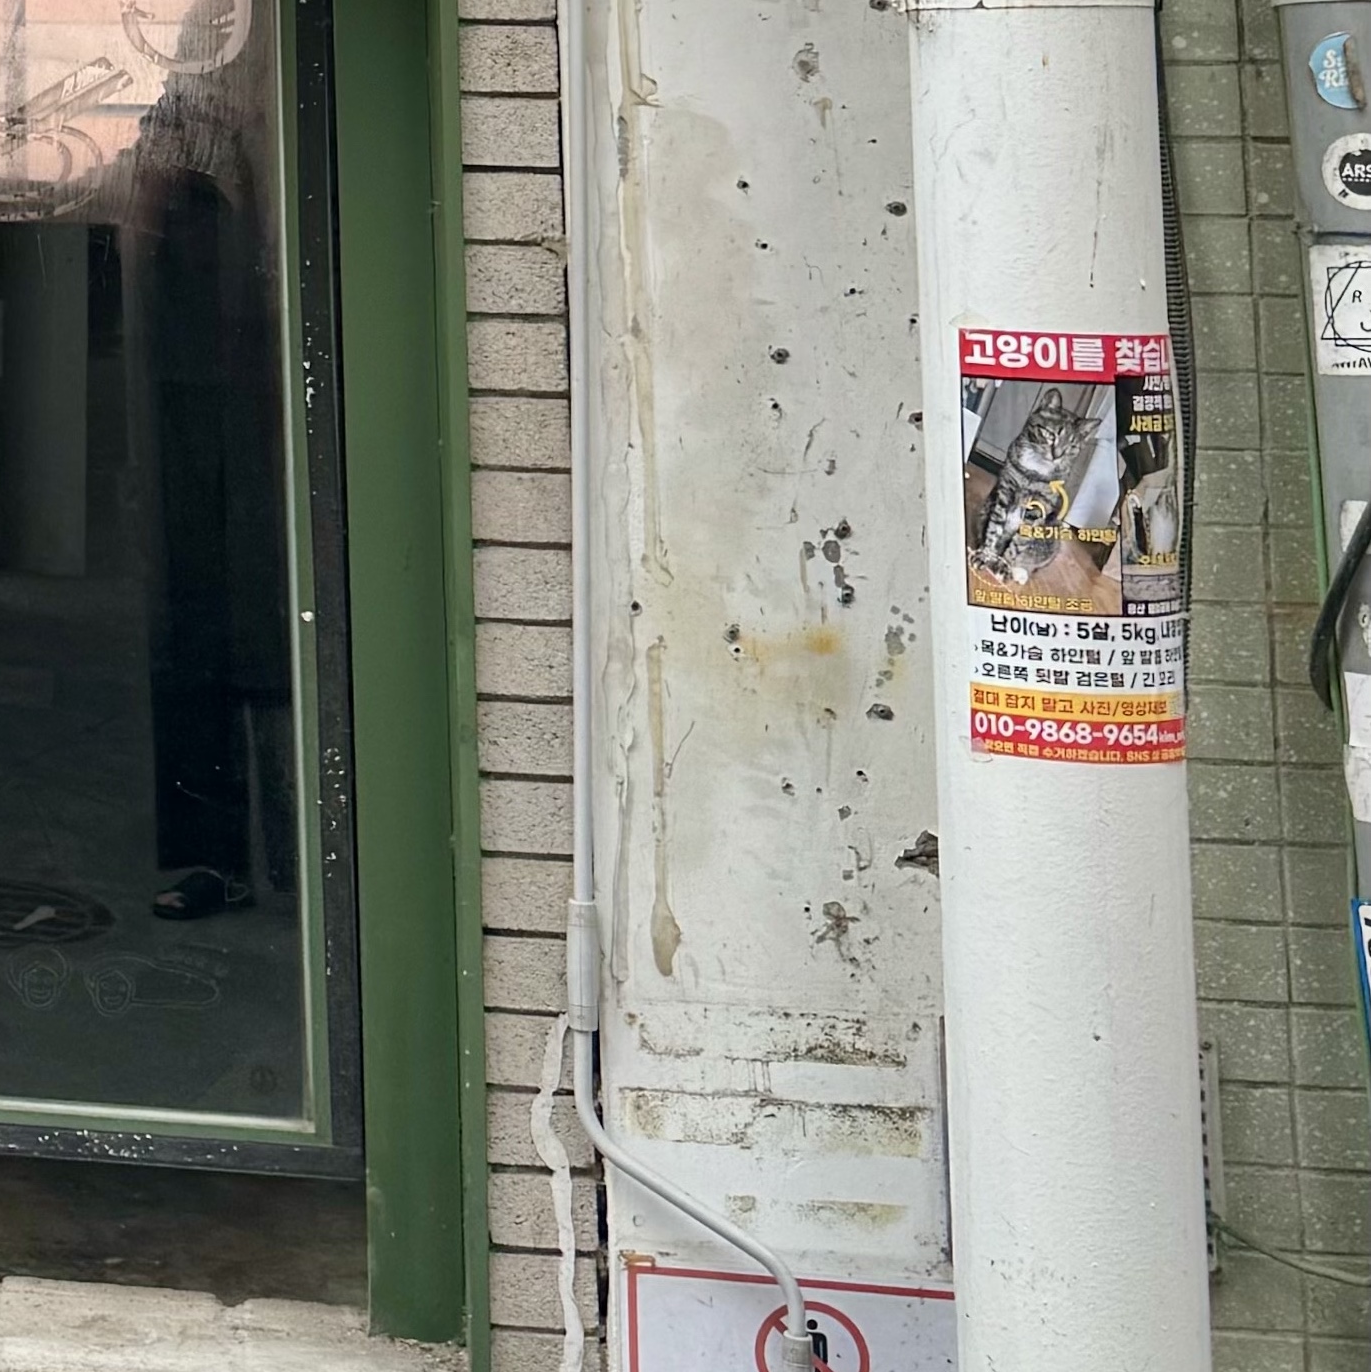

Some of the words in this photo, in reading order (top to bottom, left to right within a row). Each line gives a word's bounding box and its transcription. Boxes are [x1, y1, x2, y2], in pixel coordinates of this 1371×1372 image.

[964, 332, 1105, 372] 고양이를
[990, 614, 1057, 638] 난이(남)
[1077, 622, 1115, 642] 5살,
[981, 640, 1043, 661] 목&가슴
[1121, 649, 1136, 666] 앞
[981, 662, 1029, 682] 오른쪽
[1075, 670, 1125, 688] 검은털
[973, 688, 1000, 705] 절대
[1005, 693, 1035, 710] 잡지
[1042, 697, 1074, 714] 말고
[974, 711, 1159, 746] 010-9868-9654
[1126, 749, 1150, 762] SNS
